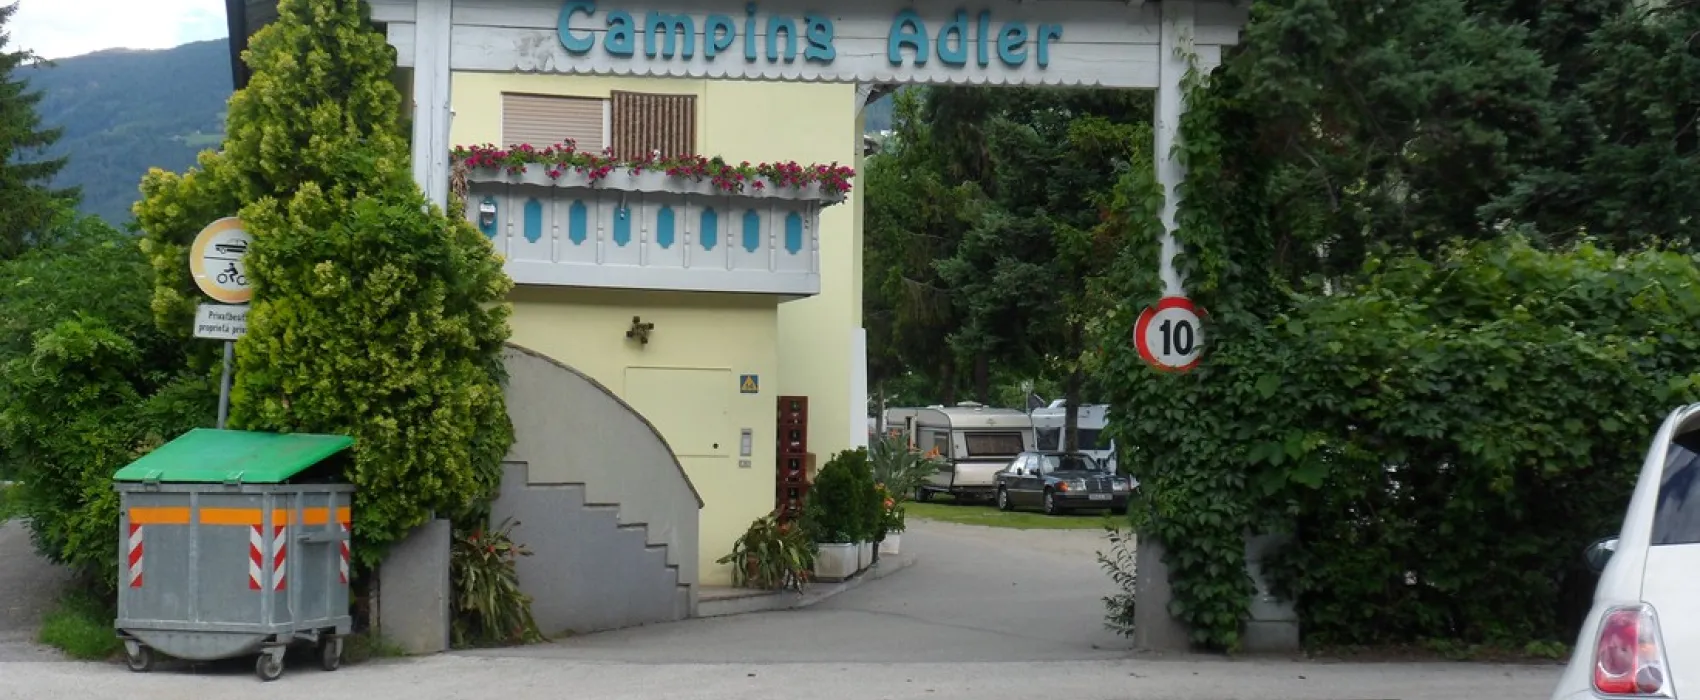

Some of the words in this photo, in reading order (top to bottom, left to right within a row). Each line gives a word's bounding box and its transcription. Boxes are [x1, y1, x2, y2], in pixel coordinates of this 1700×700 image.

[557, 0, 836, 62] Camping
[888, 8, 1062, 67] Adler
[1159, 319, 1193, 355] 10
